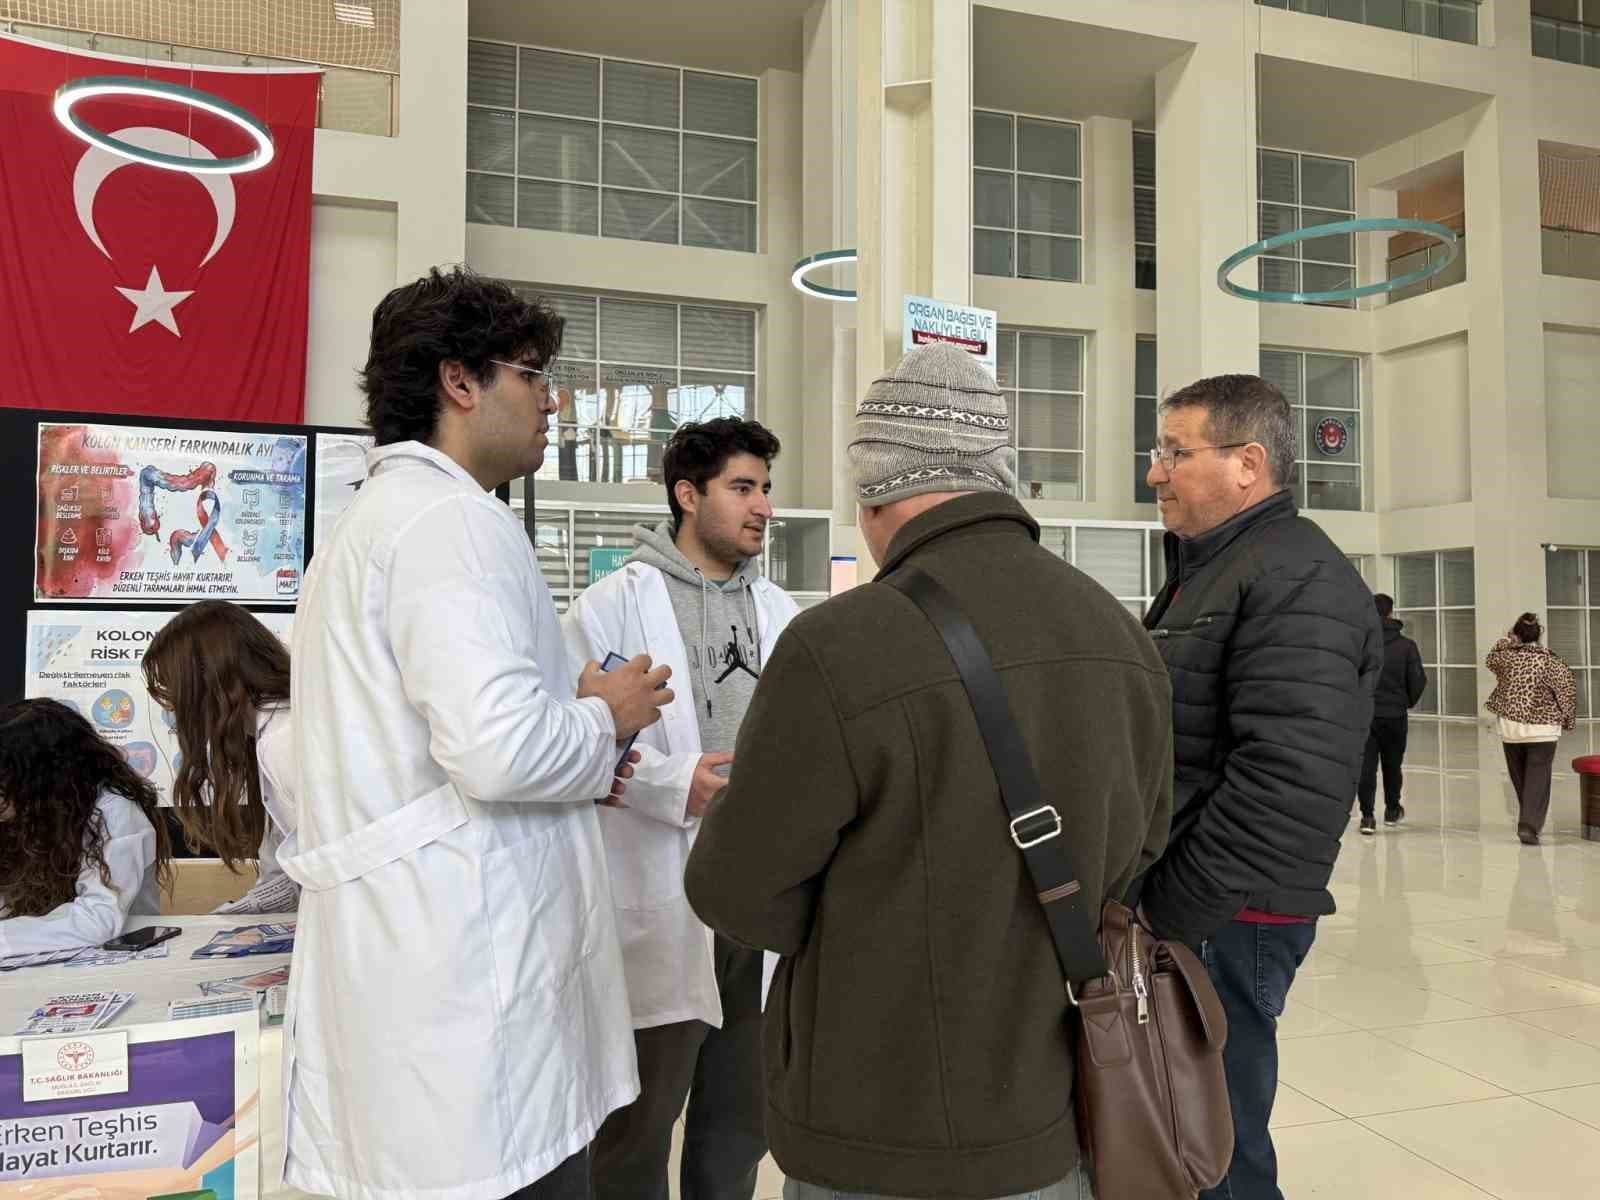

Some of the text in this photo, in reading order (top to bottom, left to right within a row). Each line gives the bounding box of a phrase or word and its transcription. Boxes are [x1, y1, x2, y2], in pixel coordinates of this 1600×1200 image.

[908, 302, 945, 320] ORGAN
[979, 315, 993, 329] VE
[81, 432, 120, 449] KOLON
[125, 435, 176, 450] KANSERİ
[179, 439, 253, 456] FARKINDALIK
[81, 465, 90, 474] VE
[233, 471, 264, 481] KORUNMA
[120, 571, 144, 581] ERKEN
[146, 571, 171, 583] TEŞHİS
[173, 572, 195, 582] HAYAT
[143, 583, 185, 593] TARAMALARI
[96, 630, 158, 641] KOLON
[91, 646, 130, 659] RİSK
[46, 1073, 75, 1083] SAĞLIK
[77, 1069, 123, 1081] BAKANLIĞI
[72, 1111, 158, 1140] Teşhis
[65, 1139, 158, 1164] Kurtarır.
